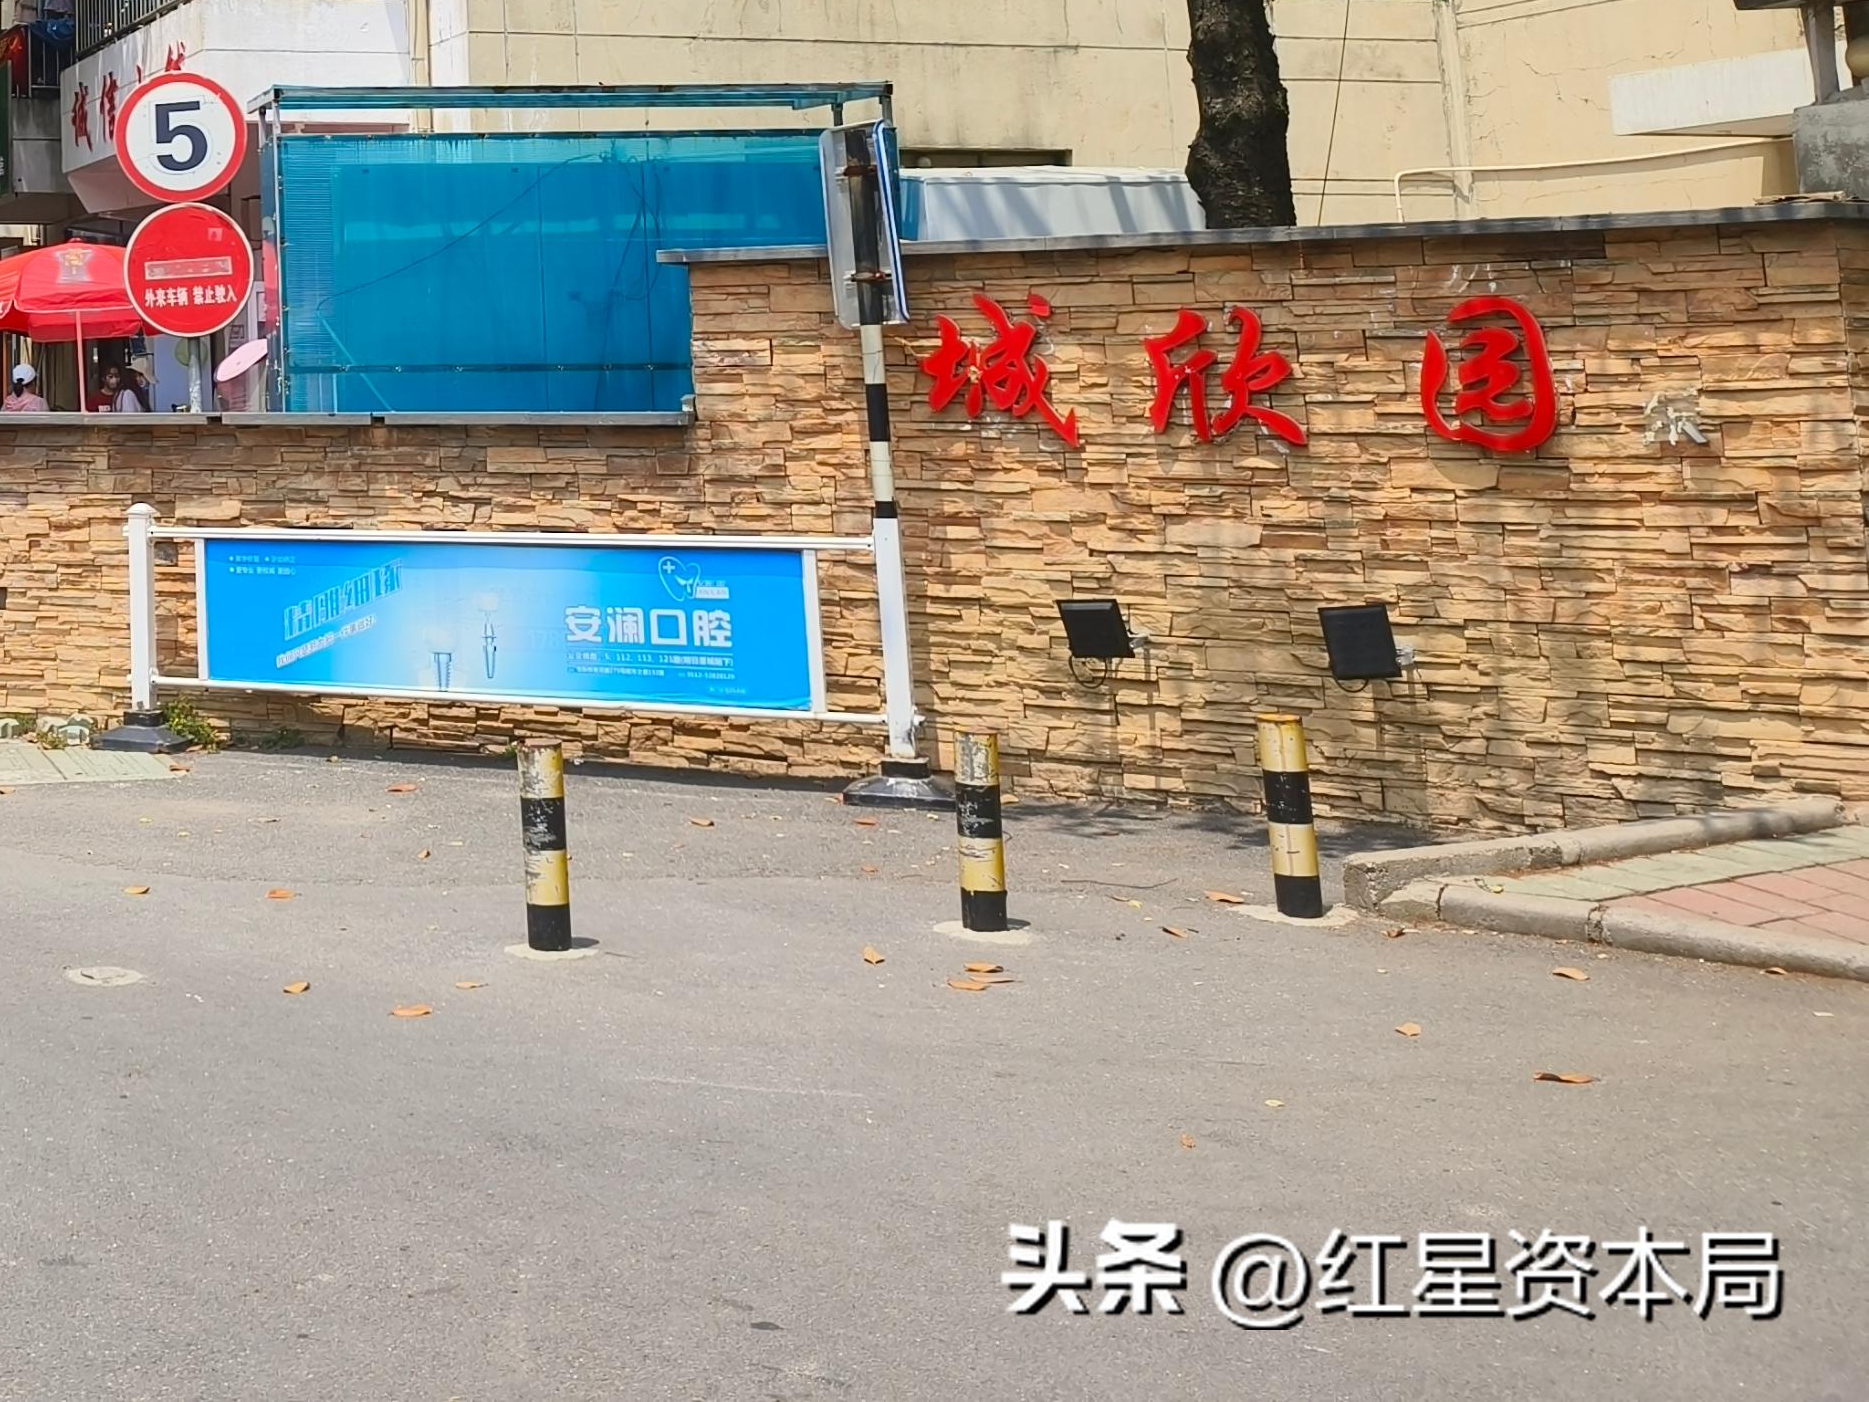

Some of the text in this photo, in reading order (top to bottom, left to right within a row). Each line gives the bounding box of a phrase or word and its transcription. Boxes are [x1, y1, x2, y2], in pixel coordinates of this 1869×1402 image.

[155, 100, 208, 172] 5
[145, 284, 237, 308] 外来车辆 禁止驶入
[564, 605, 733, 648] 安澜口腔
